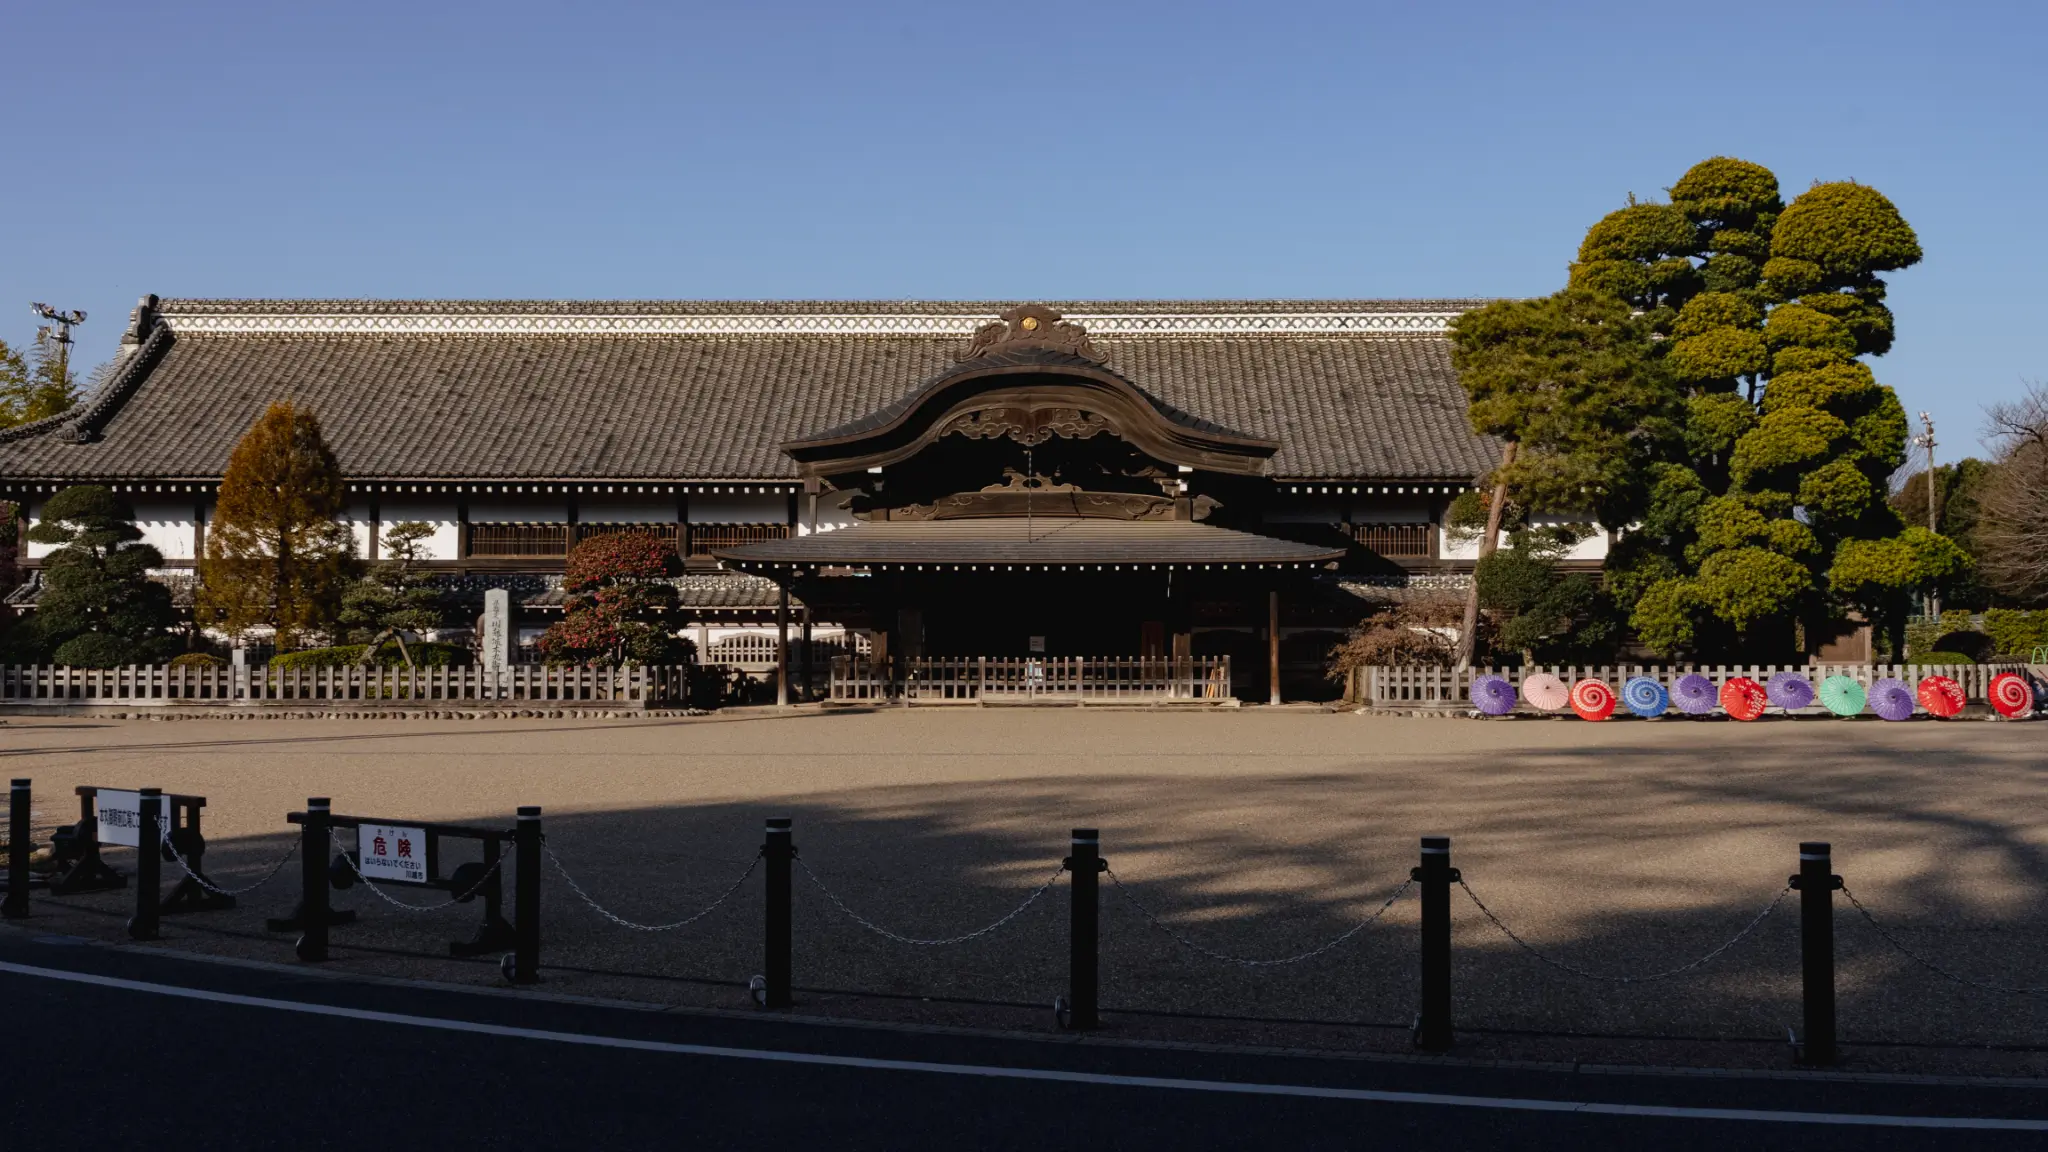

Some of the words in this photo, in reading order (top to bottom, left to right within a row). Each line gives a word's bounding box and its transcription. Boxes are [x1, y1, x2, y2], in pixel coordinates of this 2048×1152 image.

[377, 828, 408, 838] きけん
[373, 836, 412, 859] 危険
[364, 857, 422, 870] はいらないでください
[405, 870, 424, 880] 川越市
